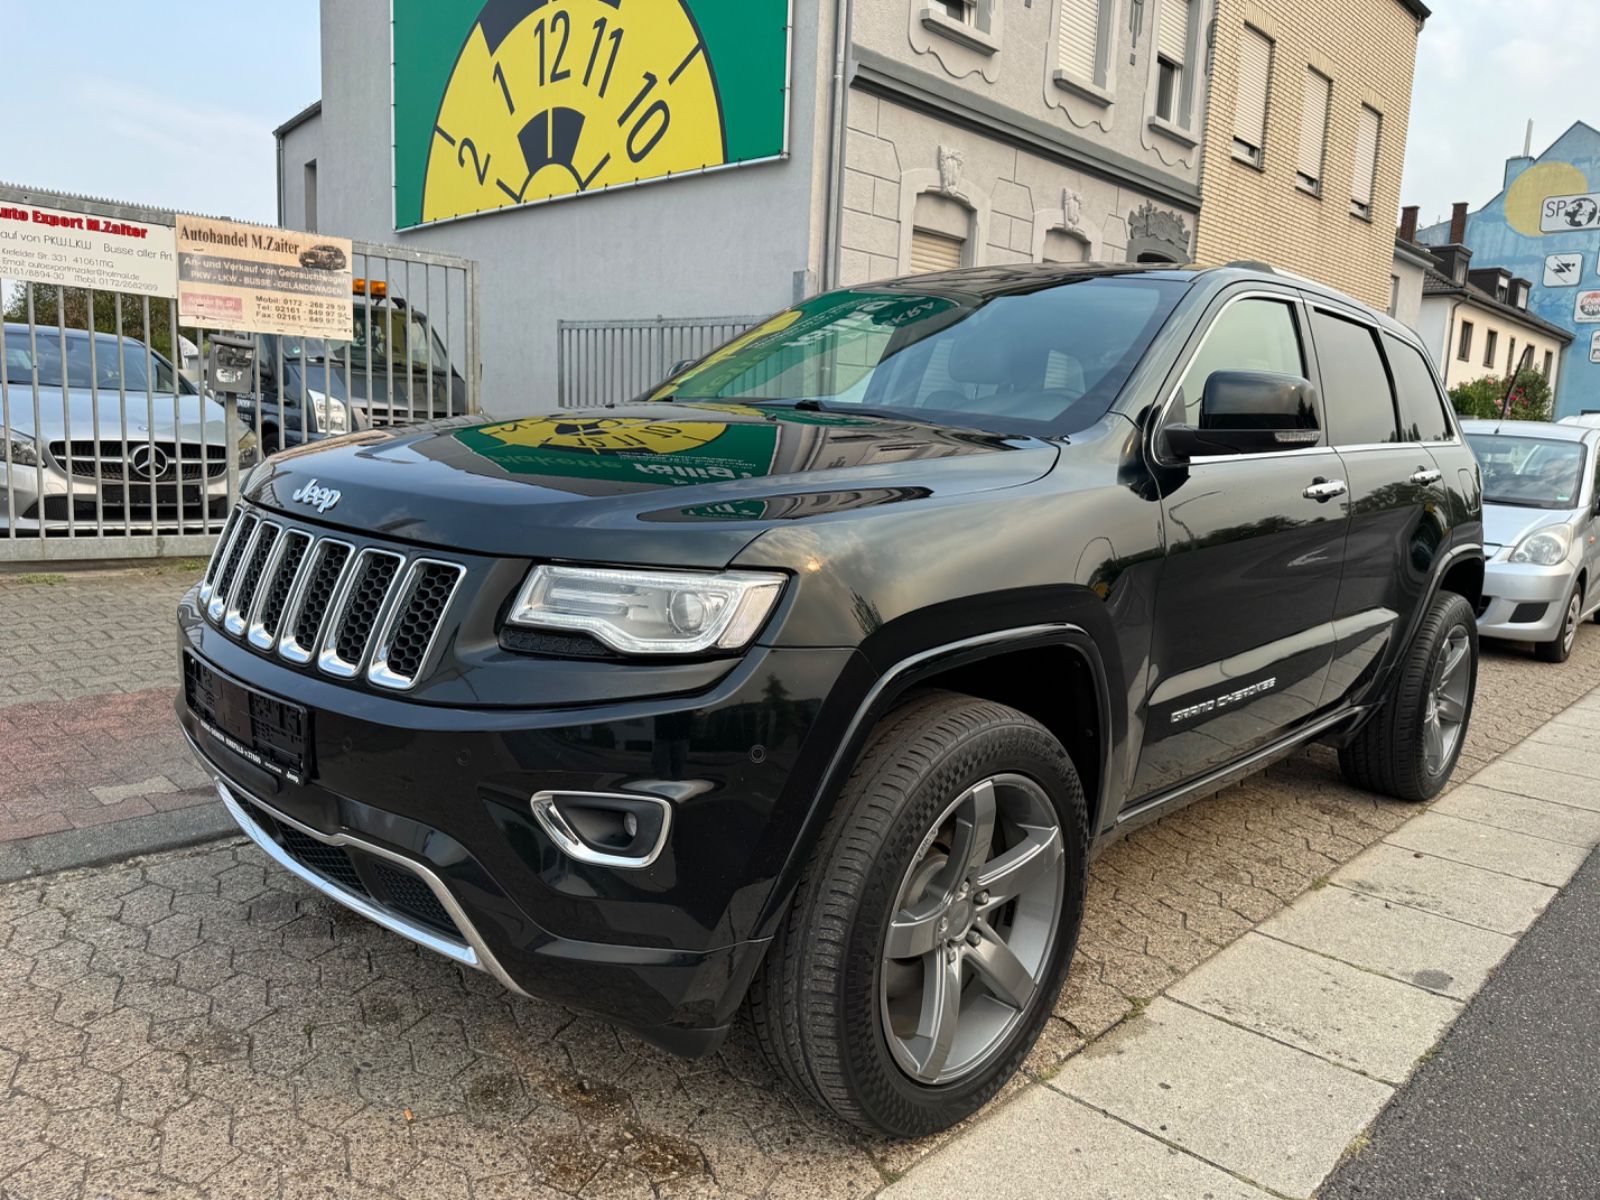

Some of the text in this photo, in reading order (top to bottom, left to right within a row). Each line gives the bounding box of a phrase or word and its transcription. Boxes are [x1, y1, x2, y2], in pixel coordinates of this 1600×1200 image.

[534, 10, 571, 87] 12
[583, 17, 624, 99] 11
[493, 61, 515, 116] 1
[617, 71, 670, 164] 10
[458, 137, 491, 186] 2
[0, 207, 29, 221] uto
[32, 210, 84, 230] Export
[20, 234, 40, 243] von
[103, 243, 134, 255] Busse
[181, 225, 299, 255] Autohandel M.Zaiter
[191, 270, 211, 280] PKW
[218, 274, 238, 283] LKW
[203, 260, 222, 269] und
[223, 262, 258, 273] Verkauf
[260, 267, 277, 276] von
[292, 478, 342, 513] Jeep
